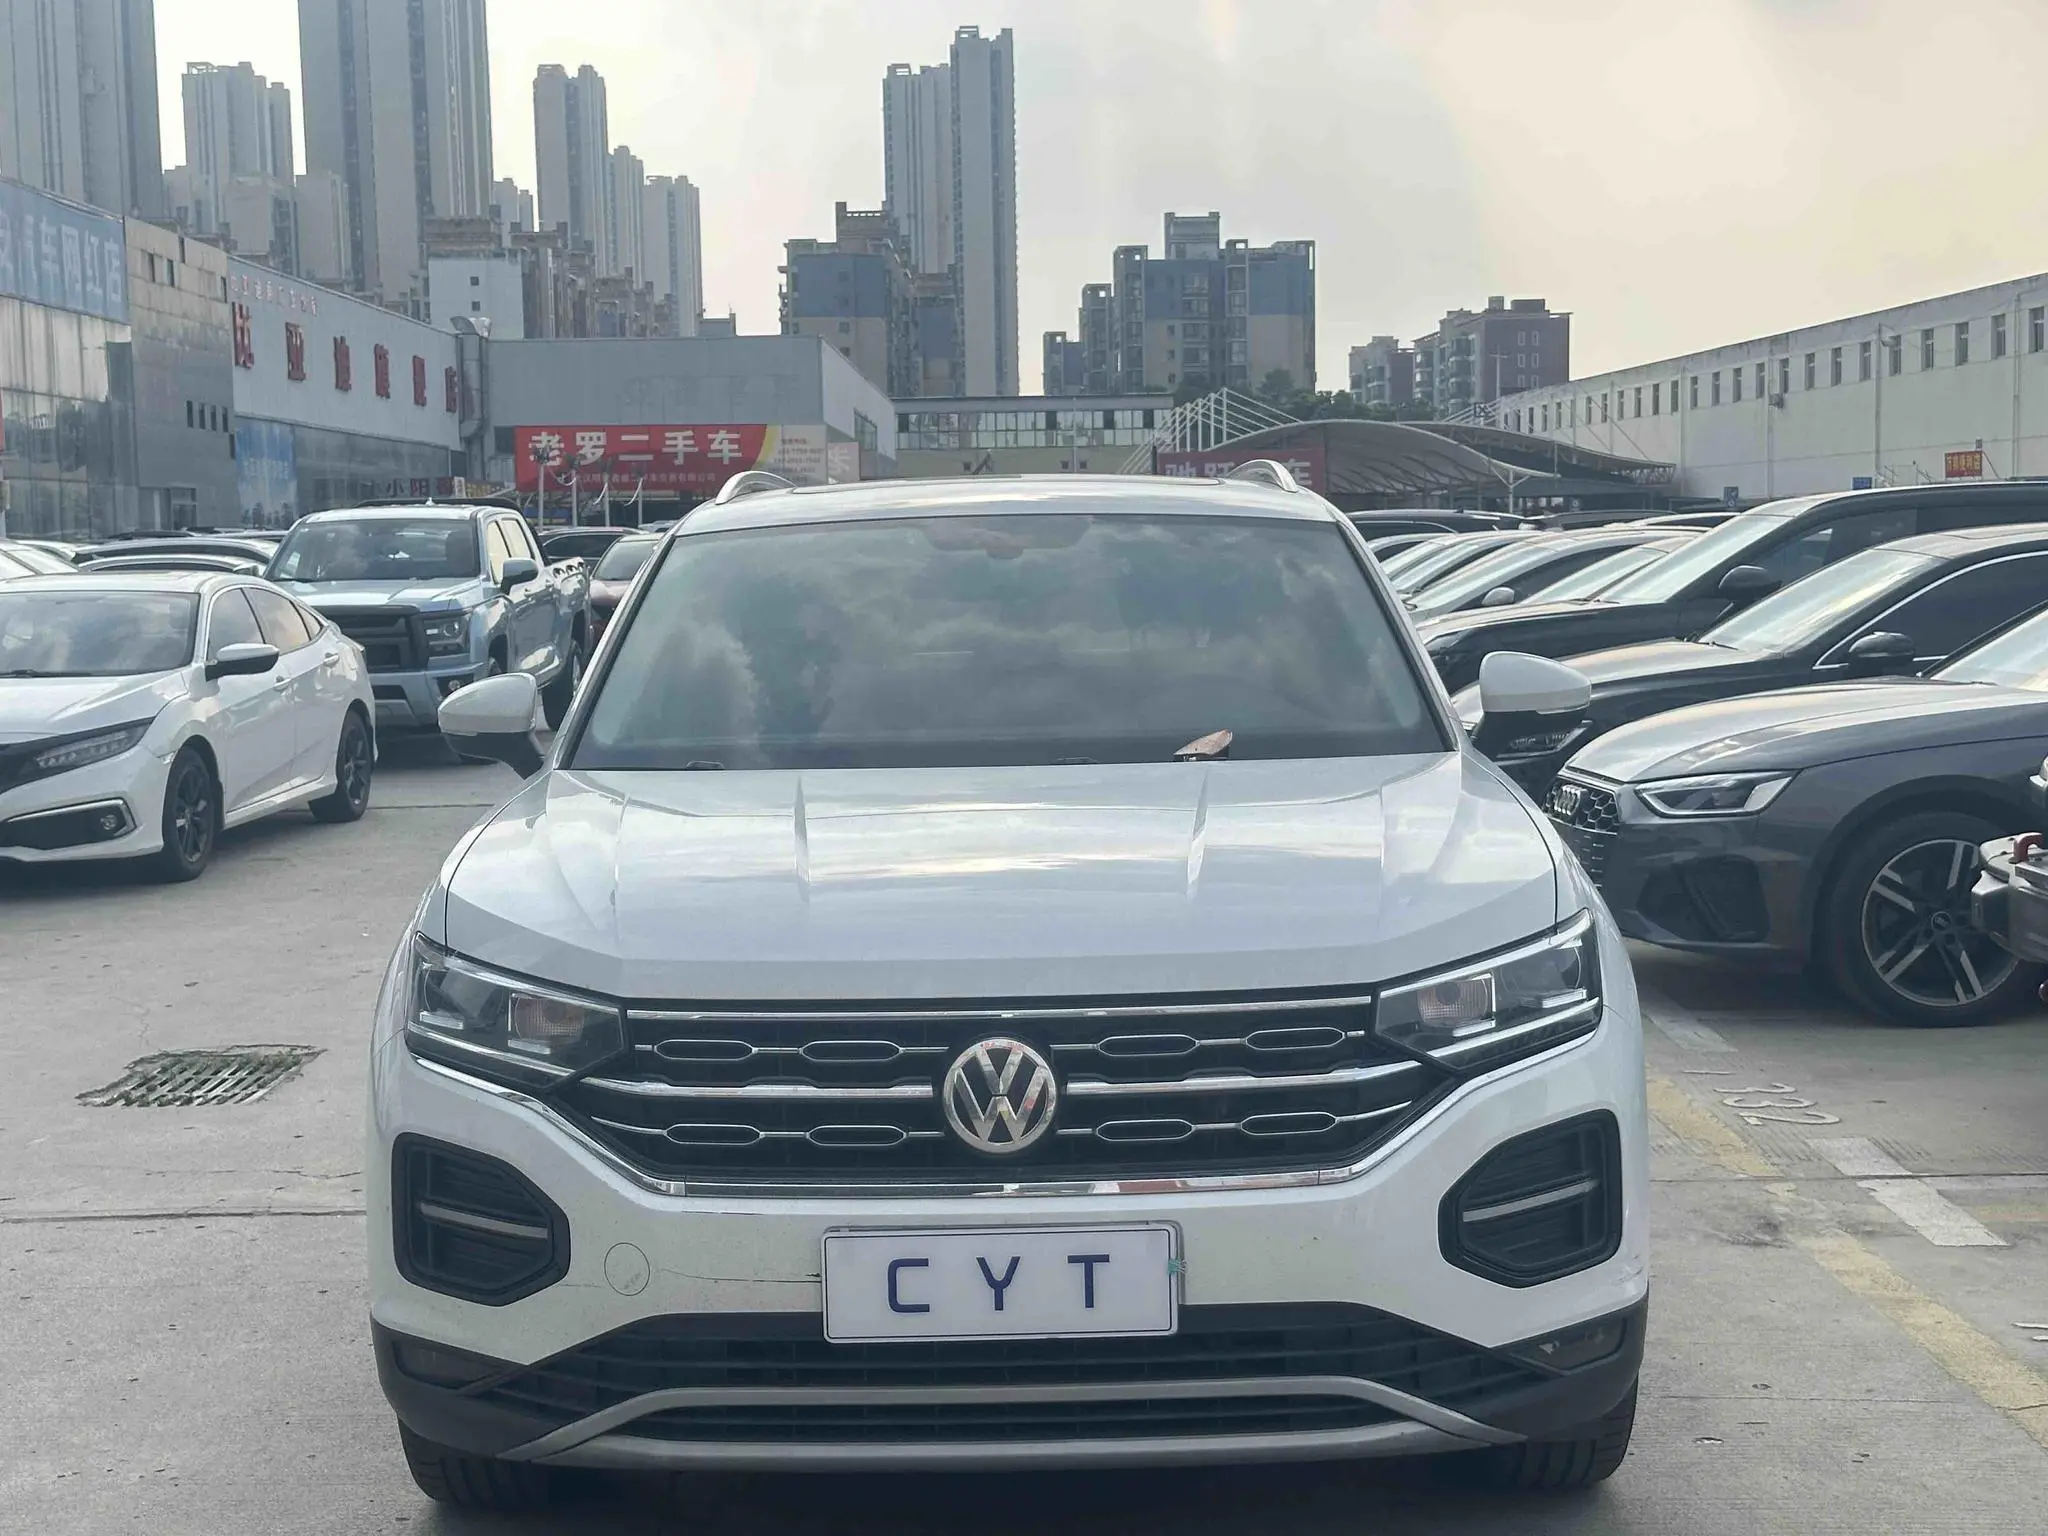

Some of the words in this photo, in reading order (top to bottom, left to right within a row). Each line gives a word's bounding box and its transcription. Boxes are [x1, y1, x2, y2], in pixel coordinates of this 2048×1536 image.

[528, 429, 743, 468] 老罗二手车
[1165, 458, 1312, 487] 驰跃车
